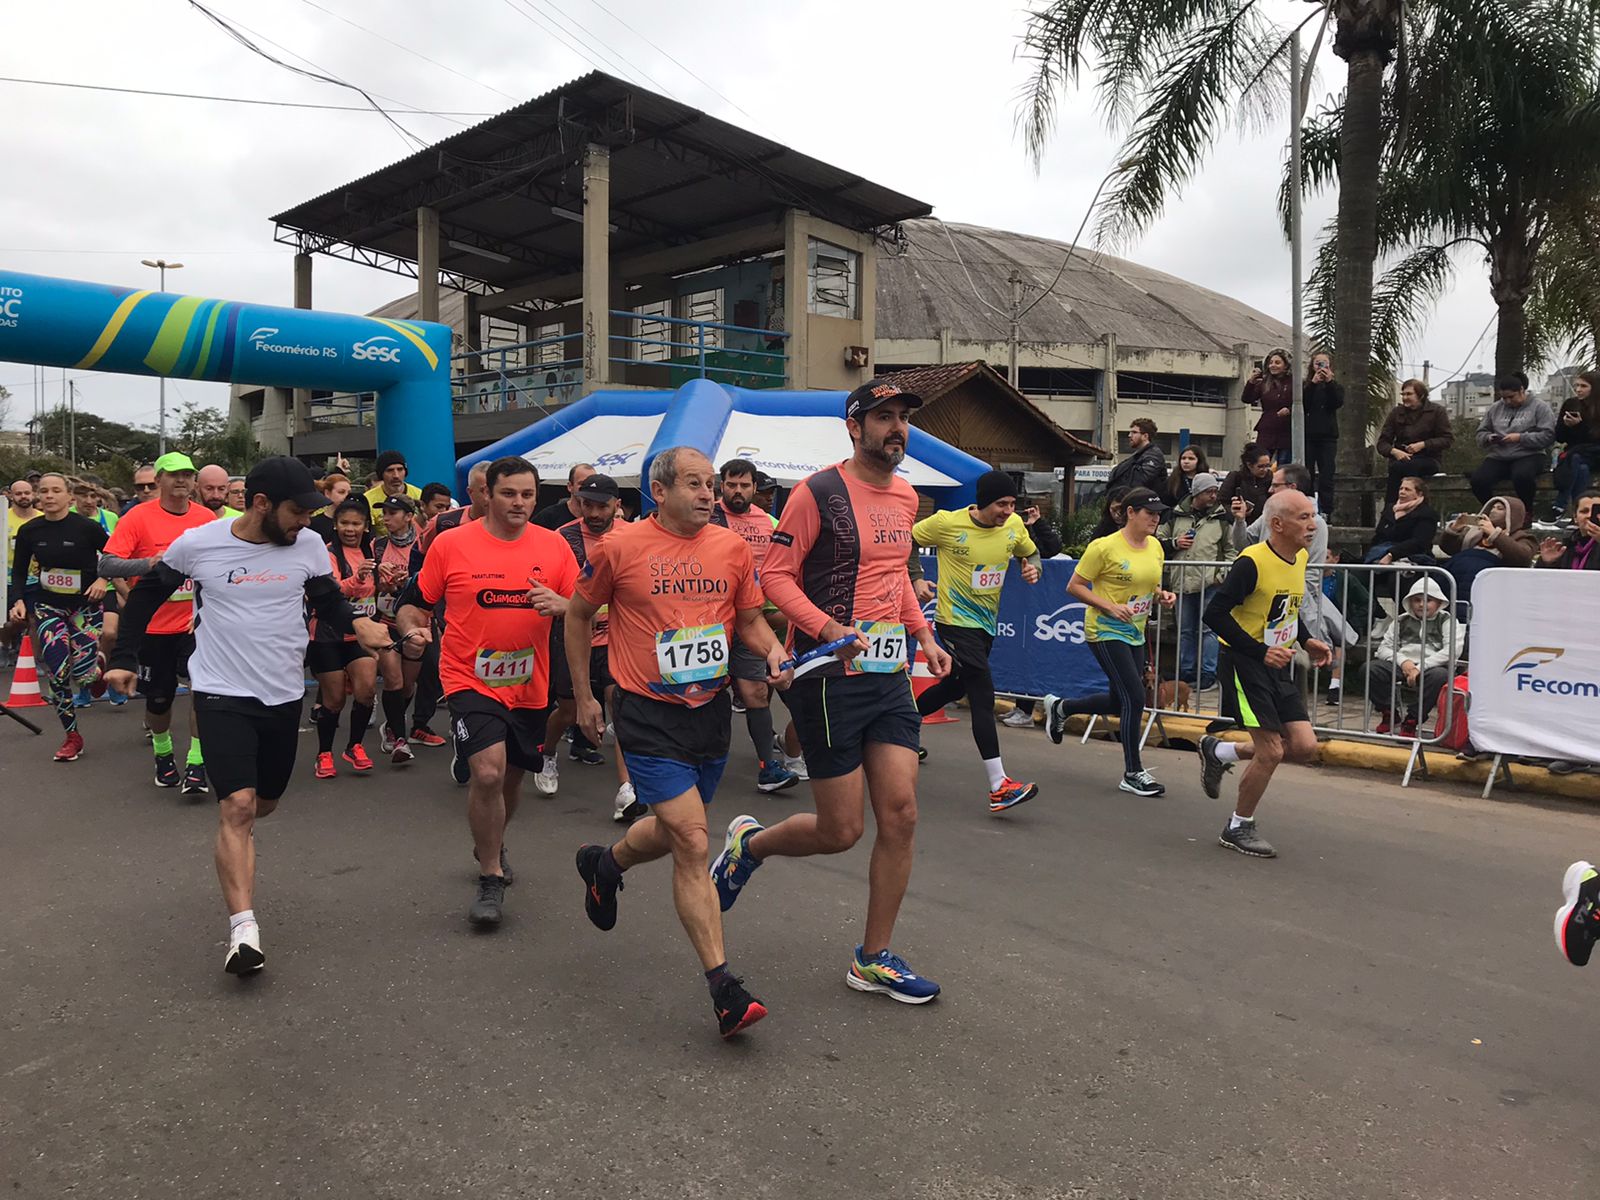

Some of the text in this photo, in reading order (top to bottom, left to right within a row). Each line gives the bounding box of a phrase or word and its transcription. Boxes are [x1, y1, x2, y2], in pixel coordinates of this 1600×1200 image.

[256, 340, 338, 358] Fecomércio RS
[352, 342, 400, 363] Sesc
[870, 513, 904, 528] SEXTO
[650, 562, 703, 577] SEXTO
[47, 574, 73, 587] 888
[651, 579, 728, 595] SENTIDO
[980, 573, 1001, 587] 873
[997, 623, 1016, 637] RS
[1033, 613, 1085, 645] Ses
[1273, 625, 1294, 645] 767
[664, 640, 724, 668] 1758
[482, 659, 527, 677] 1411
[1517, 673, 1600, 698] Fecom
